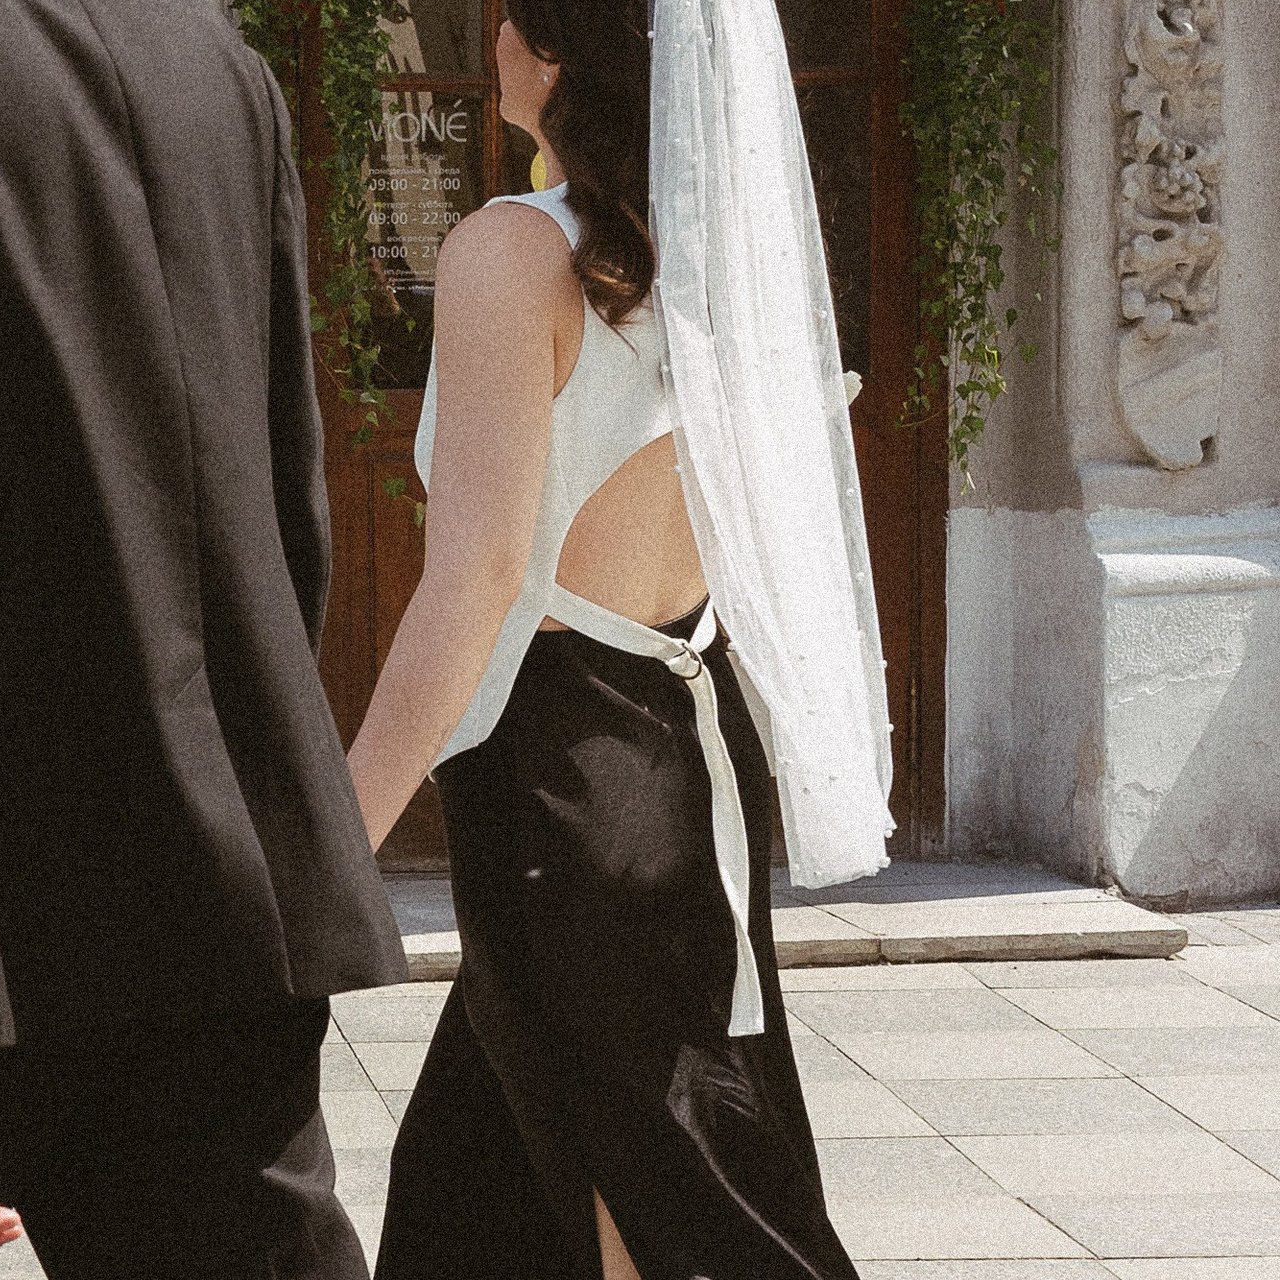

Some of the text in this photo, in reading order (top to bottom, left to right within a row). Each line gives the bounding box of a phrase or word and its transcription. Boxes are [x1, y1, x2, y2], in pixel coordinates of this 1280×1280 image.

[369, 178, 408, 191] 09:00
[422, 178, 460, 191] 21:00
[369, 212, 408, 225] 09:00
[422, 212, 460, 225] 22:00
[370, 246, 408, 259] 10:00
